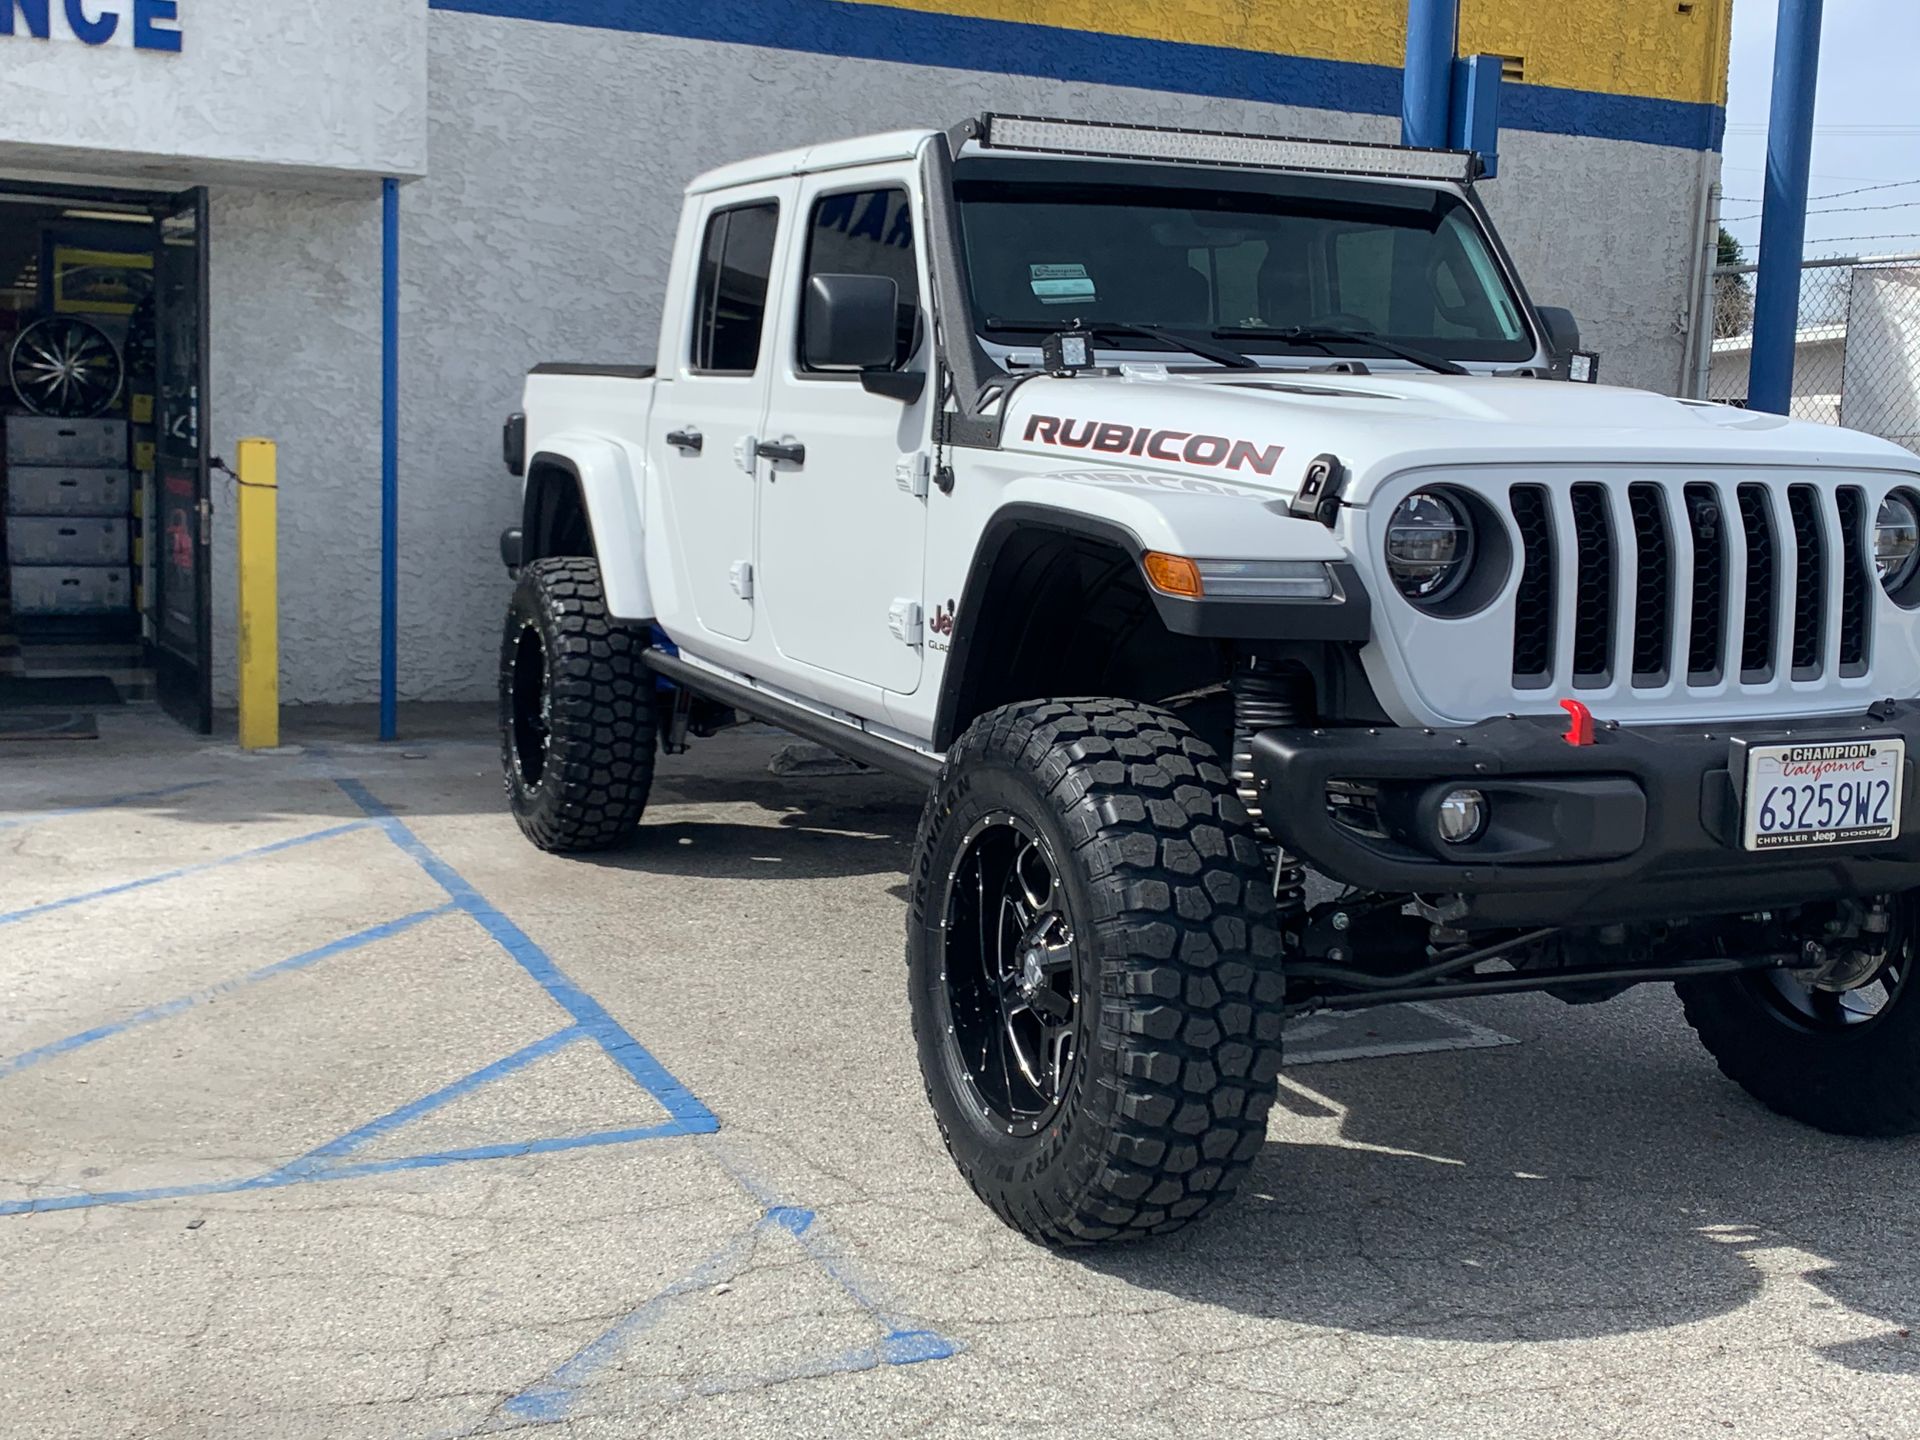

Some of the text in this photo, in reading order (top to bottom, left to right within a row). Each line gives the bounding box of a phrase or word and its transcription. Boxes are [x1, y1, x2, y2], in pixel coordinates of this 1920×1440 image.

[1022, 414, 1285, 476] RUBICON
[1792, 745, 1869, 762] CHAMPION
[1782, 759, 1875, 782] California
[1759, 779, 1891, 832] 63259W2
[1757, 829, 1882, 845] CHRYSLER Jeep DODGE
